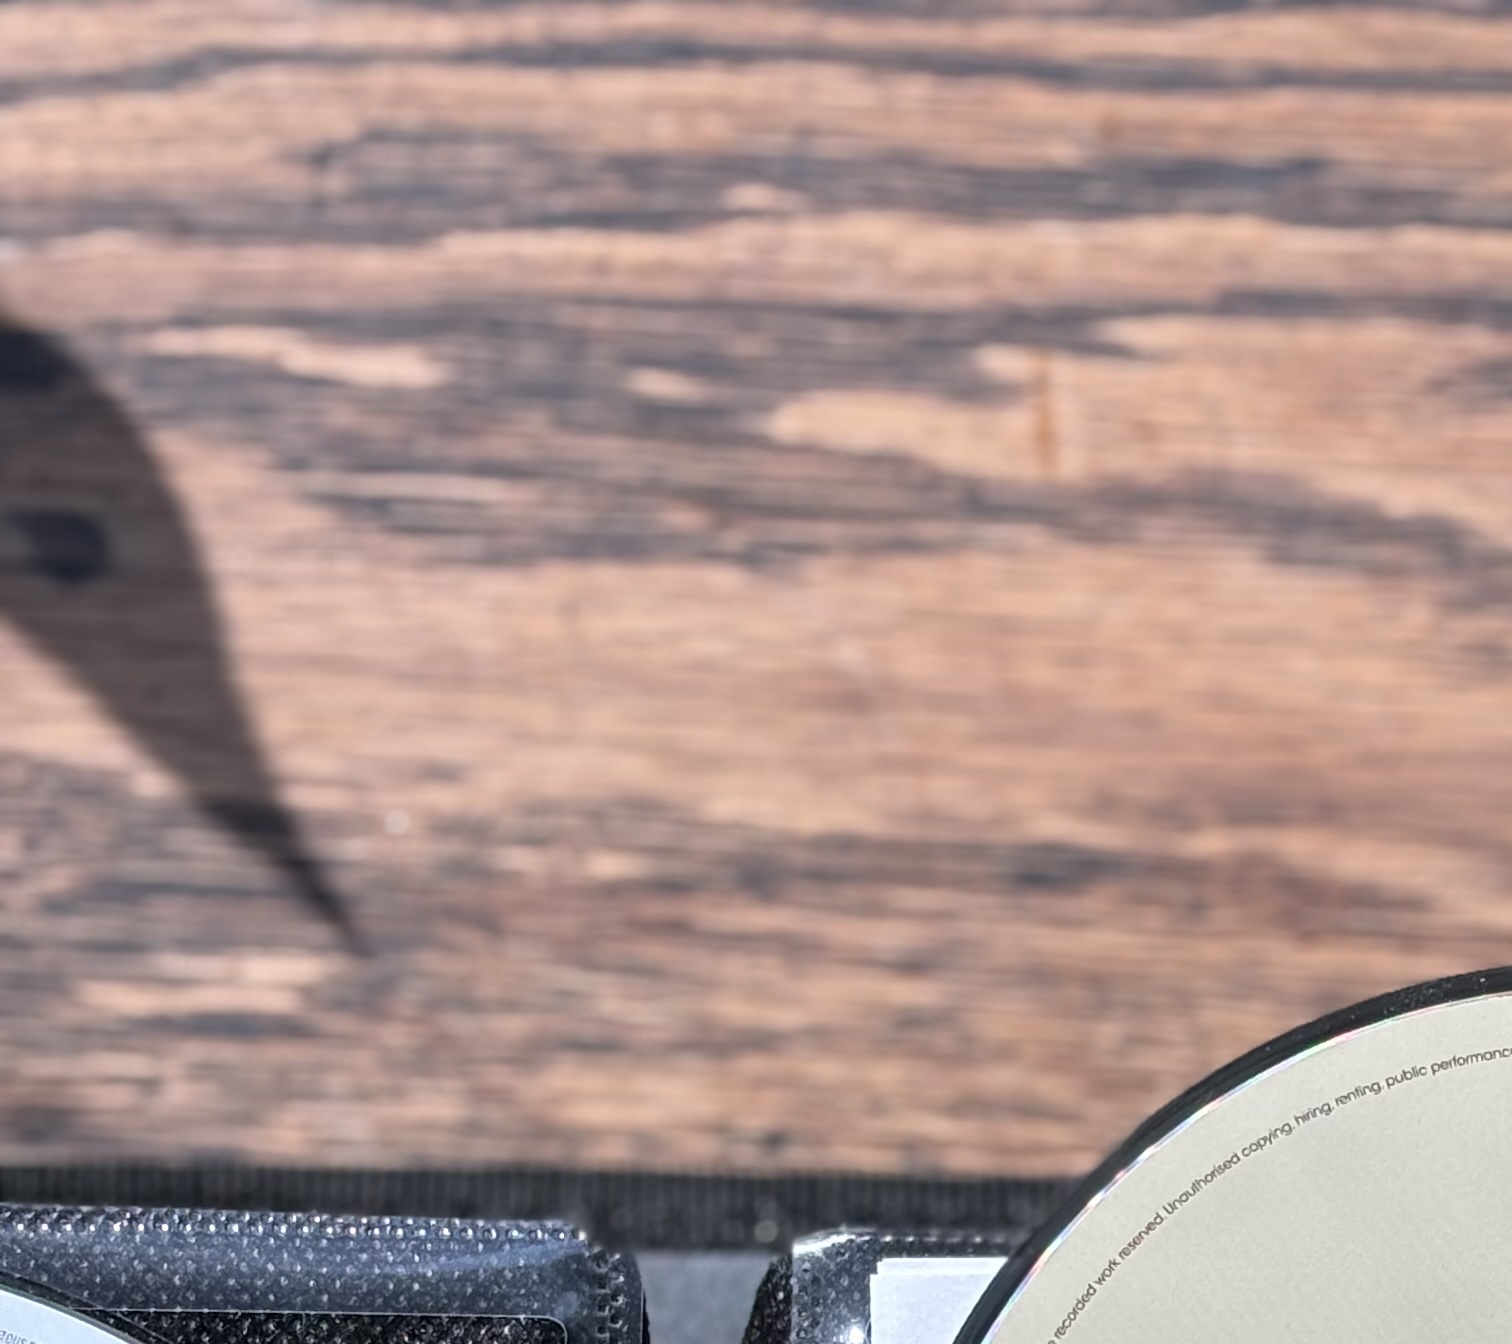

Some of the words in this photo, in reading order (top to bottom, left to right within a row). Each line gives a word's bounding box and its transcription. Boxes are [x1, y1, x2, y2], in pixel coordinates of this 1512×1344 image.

[1053, 1282, 1098, 1340] recorded
[1092, 1257, 1122, 1286] work
[1161, 1151, 1242, 1215] Unauthorised
[1384, 1065, 1428, 1090] public
